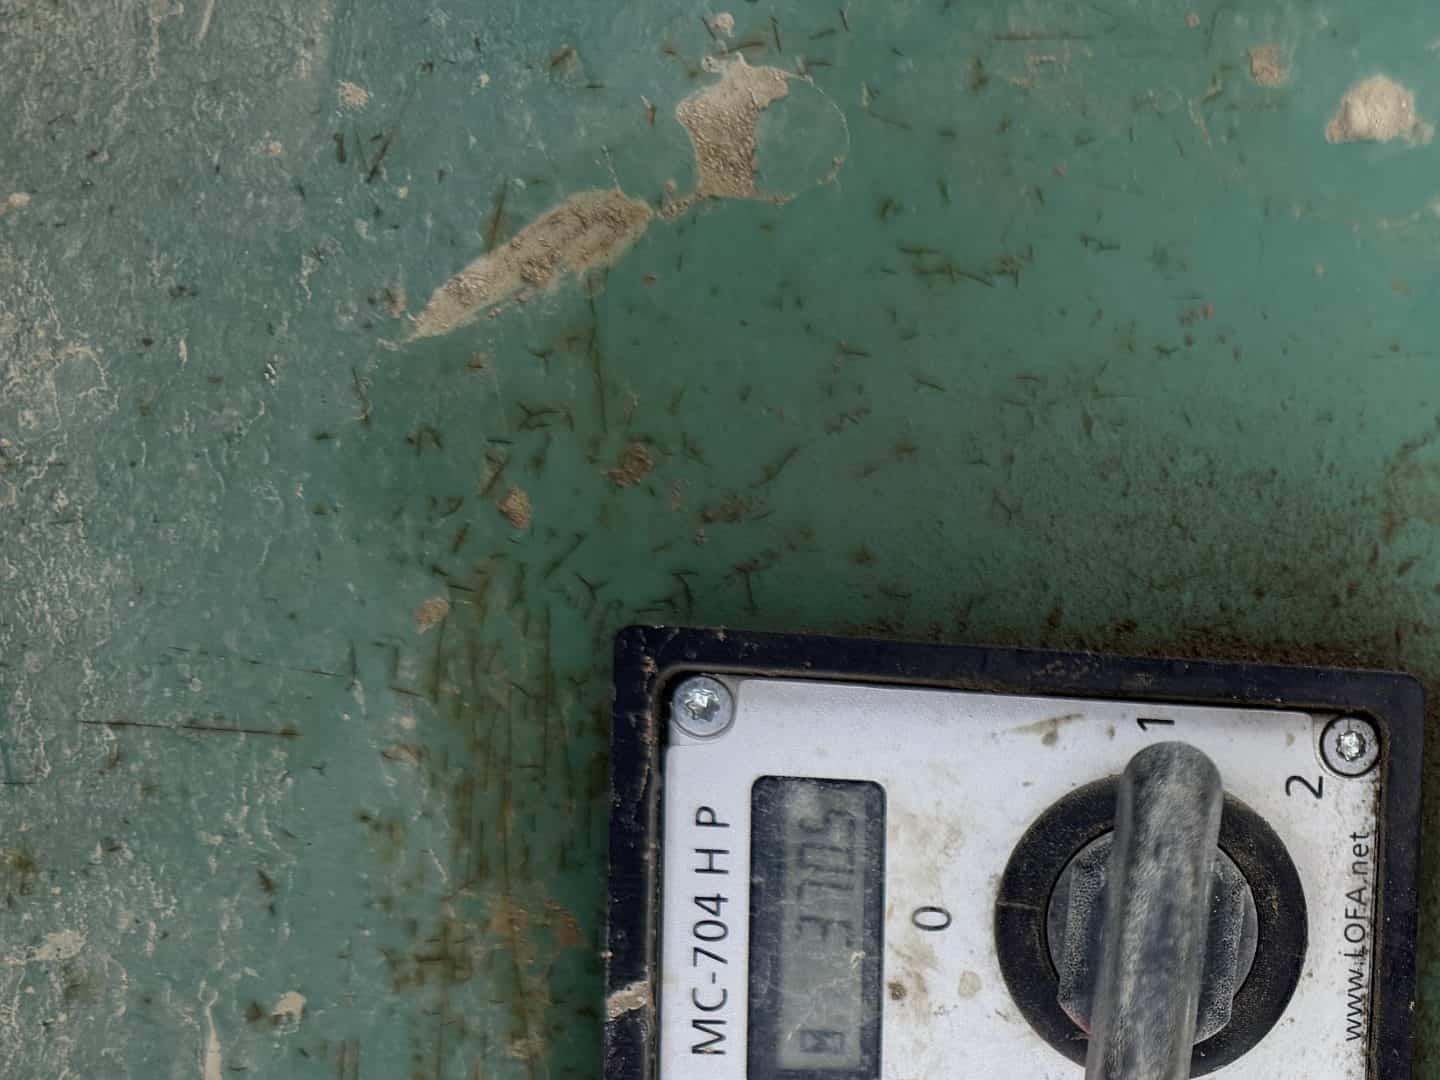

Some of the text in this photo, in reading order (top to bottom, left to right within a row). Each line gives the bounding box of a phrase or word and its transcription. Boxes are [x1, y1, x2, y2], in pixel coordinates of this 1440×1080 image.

[1136, 717, 1175, 731] 1
[1285, 775, 1324, 799] 2
[911, 906, 952, 931] 0
[1343, 830, 1371, 1042] www.LOFA.net
[691, 893, 729, 1055] MC-704
